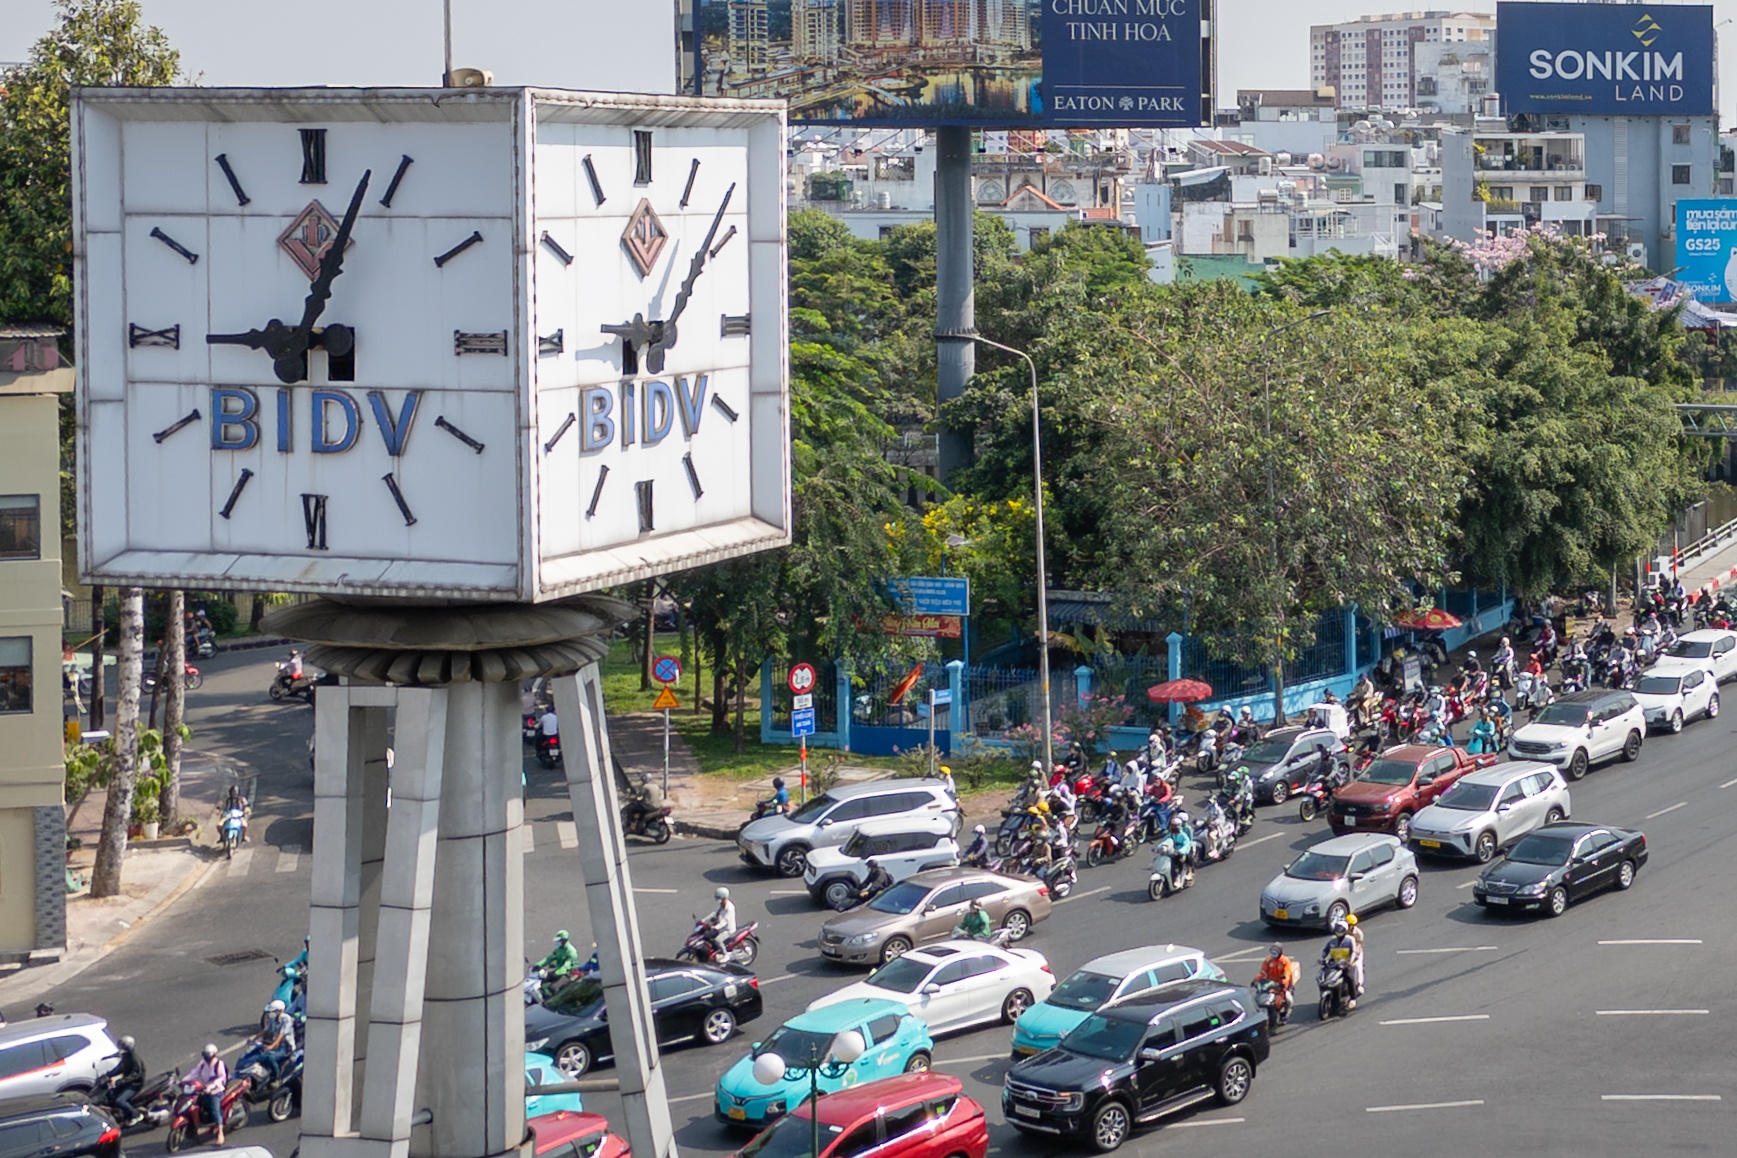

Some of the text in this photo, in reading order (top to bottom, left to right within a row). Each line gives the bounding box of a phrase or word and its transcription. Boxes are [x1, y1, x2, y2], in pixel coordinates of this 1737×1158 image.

[1066, 22, 1172, 41] TINH HOA
[1529, 49, 1683, 81] SONKIM
[1615, 84, 1684, 102] LAND
[1054, 96, 1185, 111] EATON PARK
[1686, 209, 1714, 219] mua
[1685, 238, 1721, 251] GS25
[210, 386, 423, 457] BIDV
[580, 374, 708, 451] BIDV
